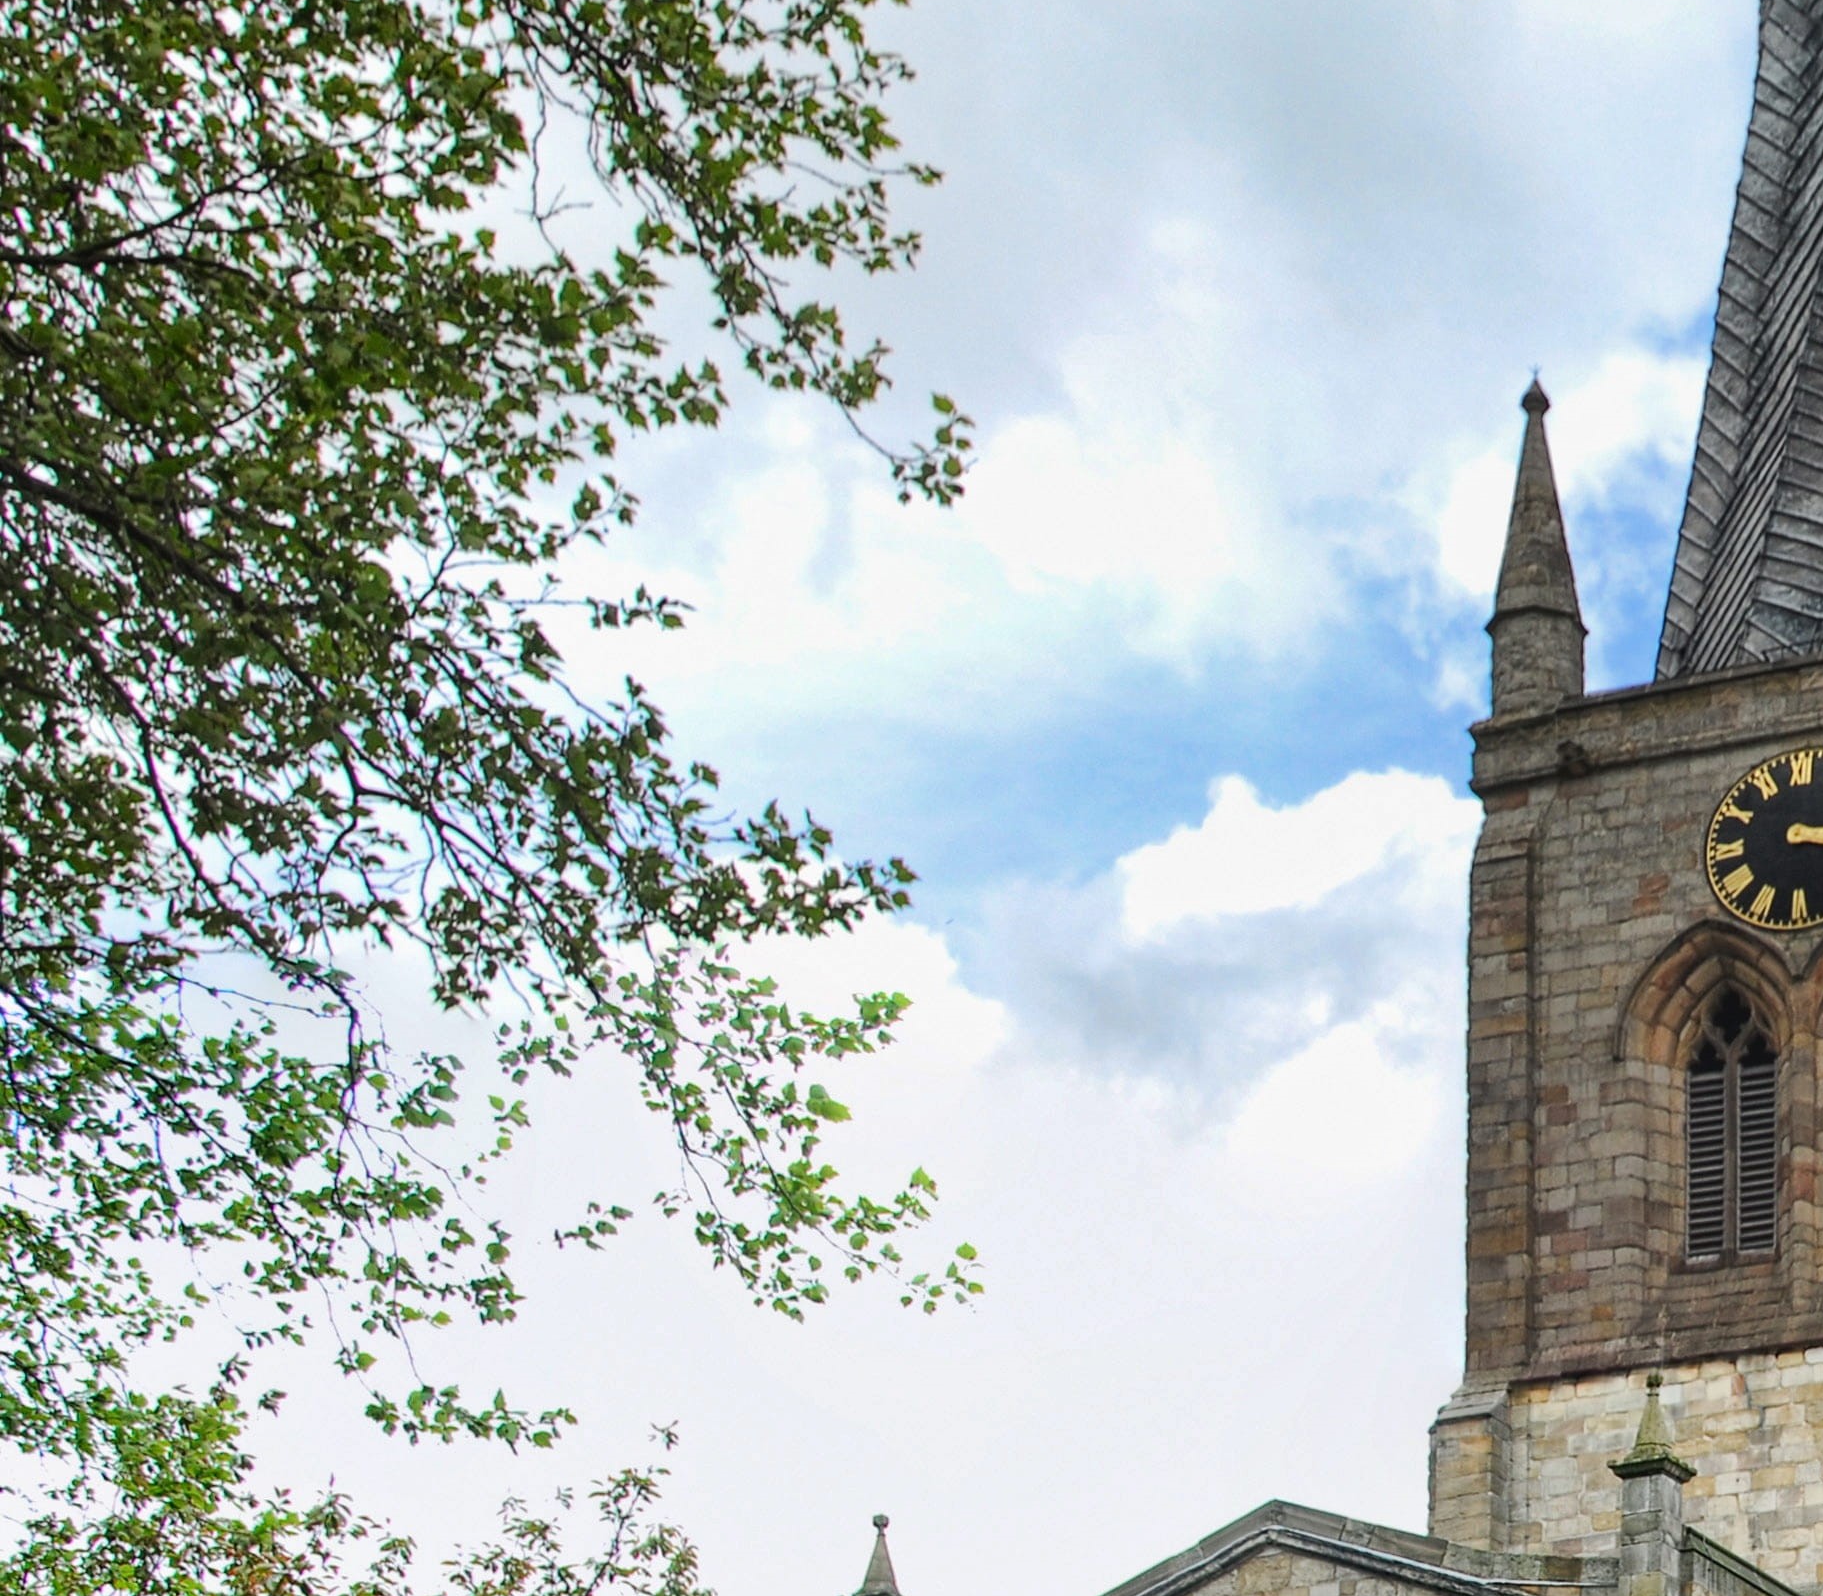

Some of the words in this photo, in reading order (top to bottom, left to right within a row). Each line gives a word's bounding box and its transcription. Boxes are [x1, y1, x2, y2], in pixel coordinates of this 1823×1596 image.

[1752, 767, 1779, 801] XI
[1790, 752, 1813, 786] XII
[1724, 805, 1754, 824] X
[1715, 838, 1744, 861] IX
[1722, 864, 1754, 898] VIII
[1750, 884, 1776, 918] VII
[1792, 888, 1808, 920] VI
